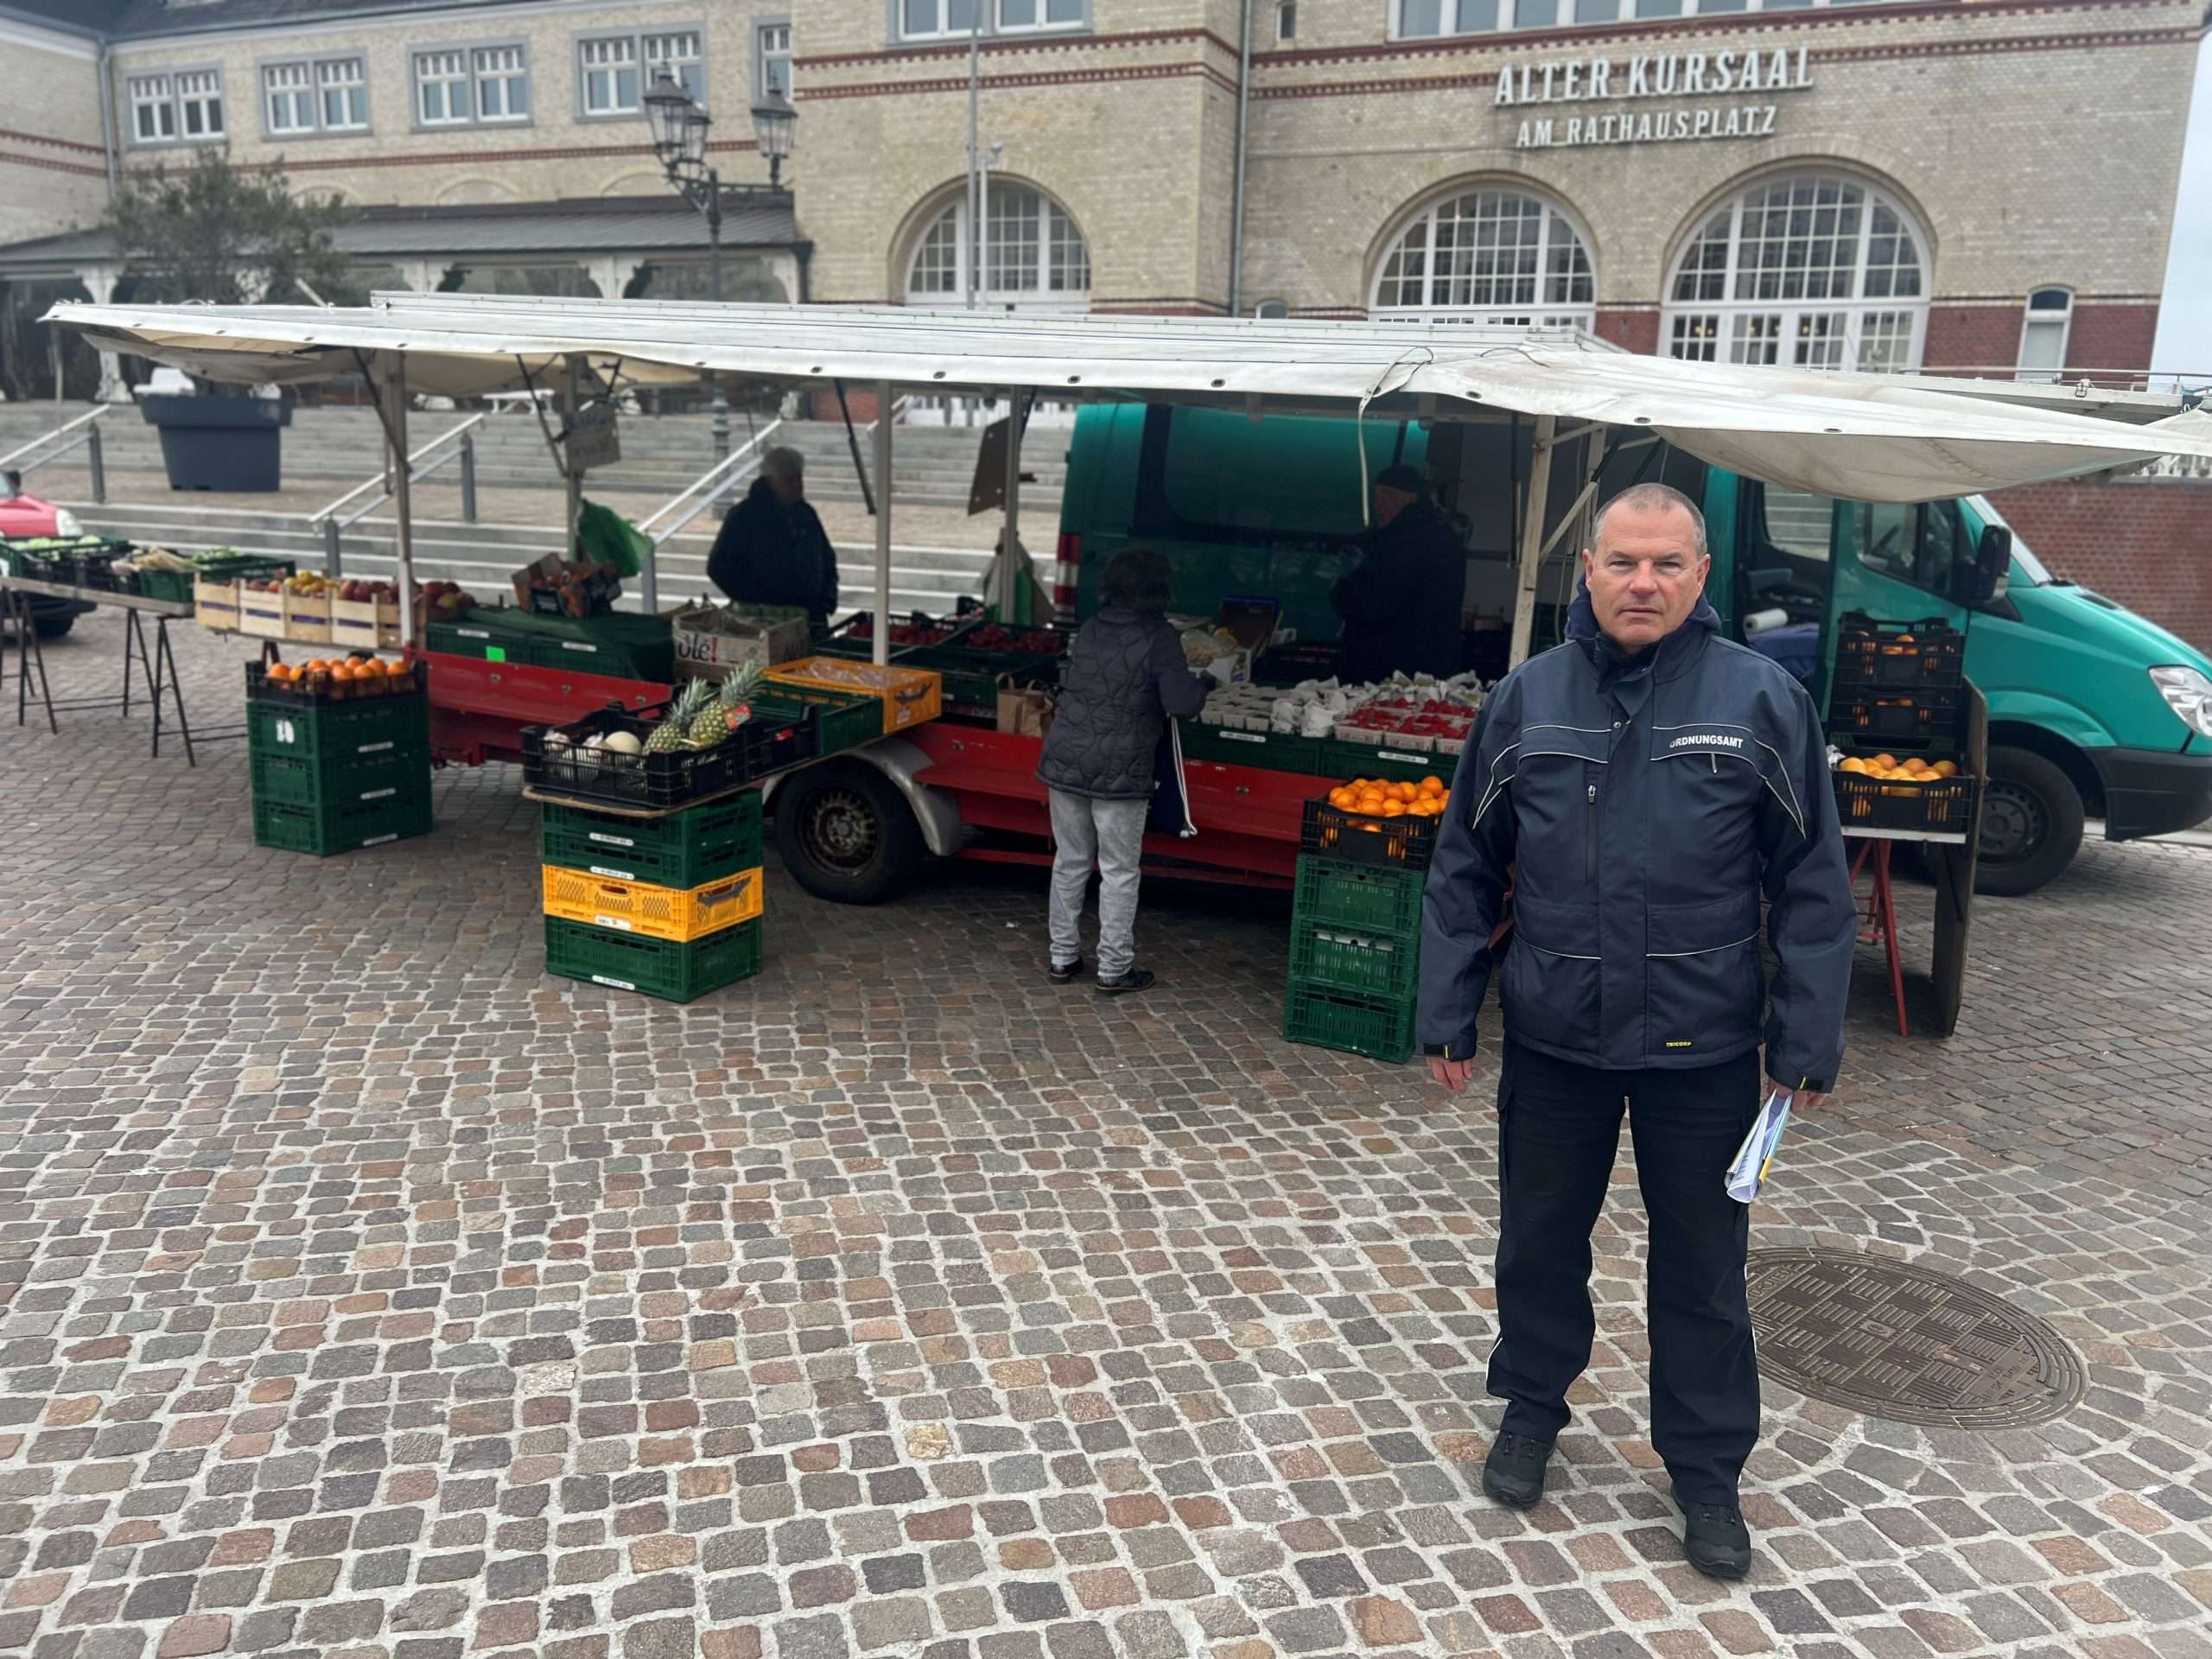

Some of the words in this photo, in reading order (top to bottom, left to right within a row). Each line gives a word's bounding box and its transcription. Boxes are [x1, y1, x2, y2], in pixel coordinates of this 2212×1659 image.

[1494, 56, 1611, 105] ALTER
[1628, 44, 1814, 97] KURSAAL
[1516, 119, 1553, 147] AM
[1567, 106, 1777, 144] RATHAUSPLATZ
[1669, 734, 1744, 748] ORDNUNGSAMT
